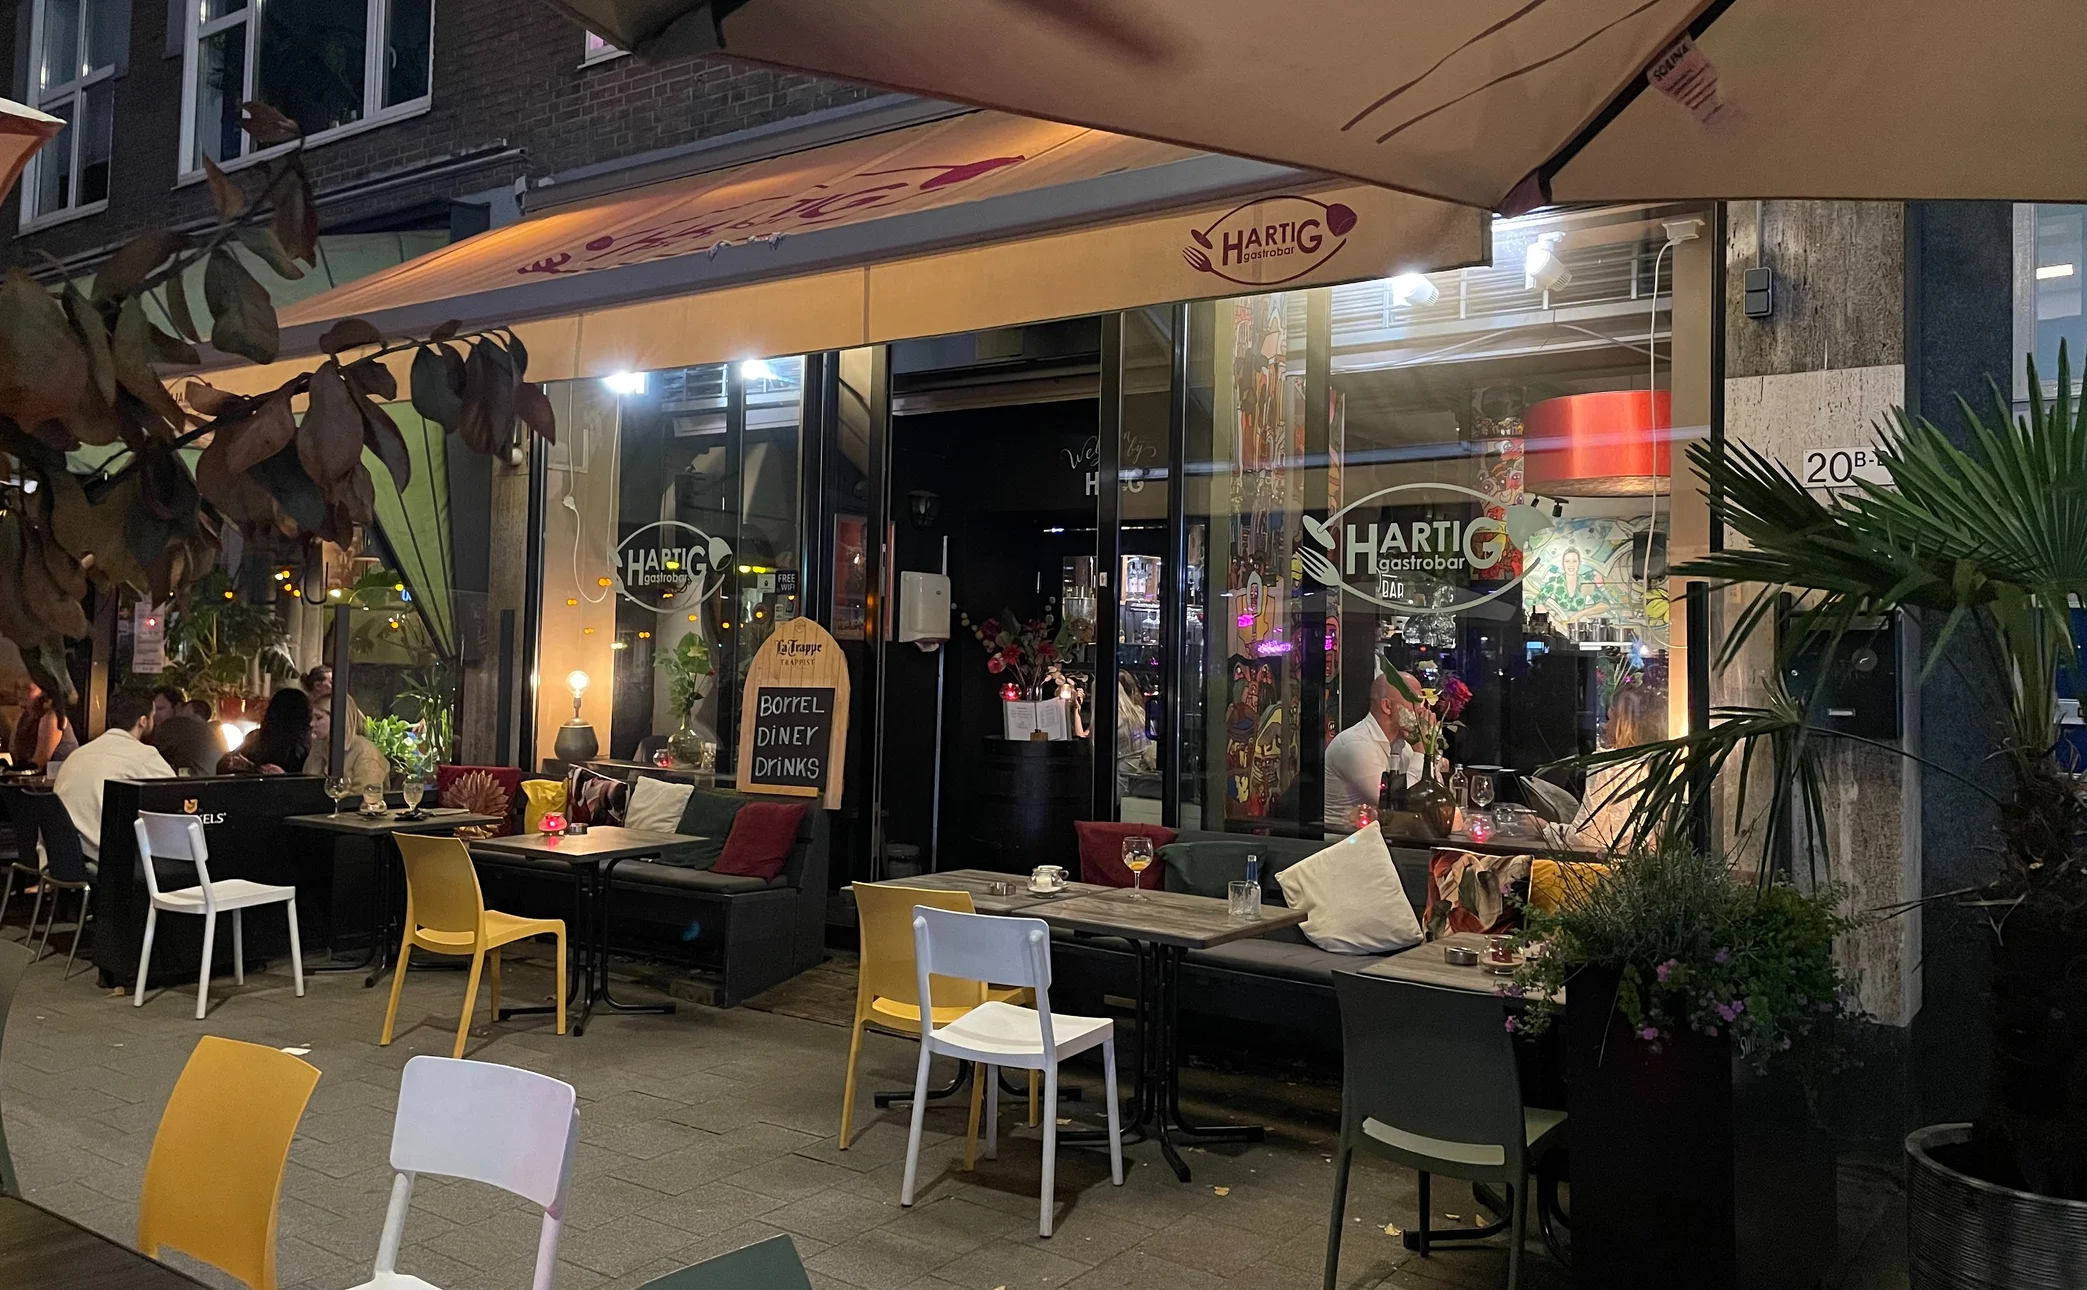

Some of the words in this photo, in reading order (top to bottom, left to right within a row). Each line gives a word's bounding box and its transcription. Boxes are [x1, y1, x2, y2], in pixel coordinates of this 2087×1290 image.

[1222, 218, 1323, 266] HARTIG
[1243, 245, 1295, 263] gastrobar
[1346, 516, 1503, 575] HARTIG
[627, 545, 707, 586] HARTIG
[1379, 554, 1466, 573] gastrobar
[644, 572, 688, 585] gastrobar
[777, 574, 796, 583] FREE
[1382, 580, 1404, 599] BAR
[788, 639, 822, 657] Trappe
